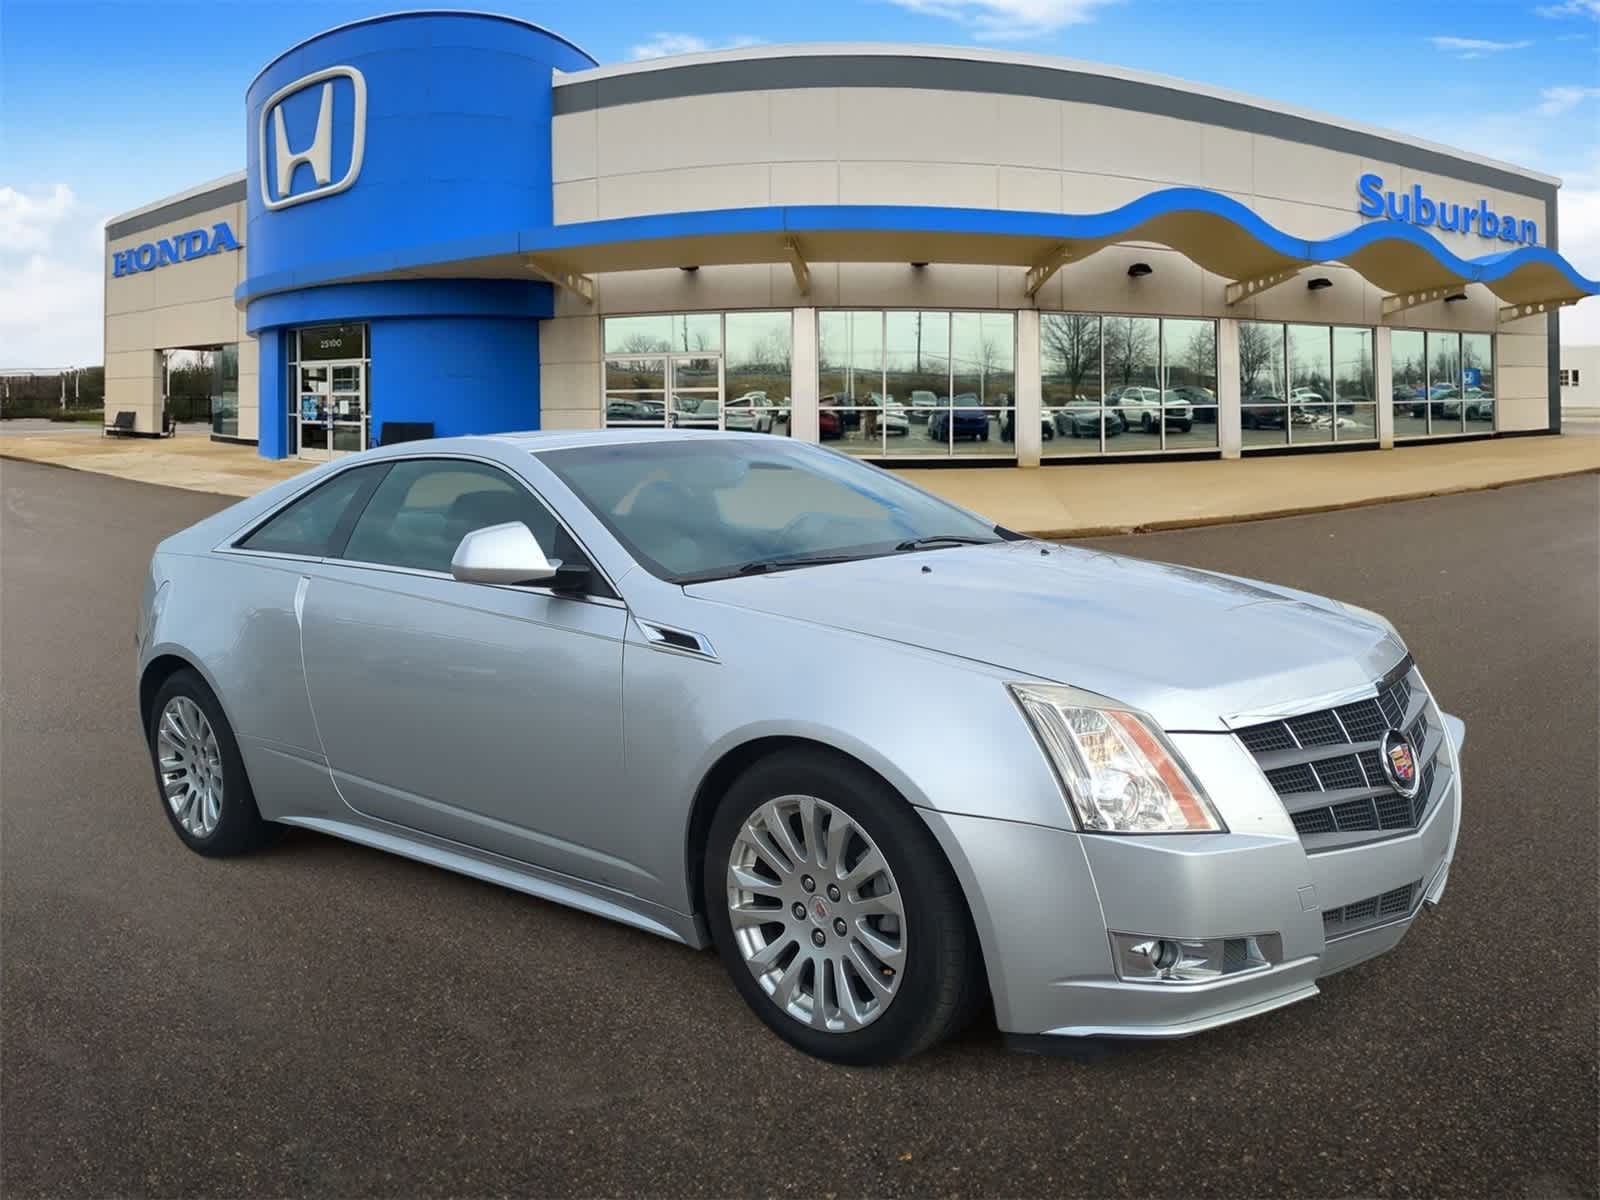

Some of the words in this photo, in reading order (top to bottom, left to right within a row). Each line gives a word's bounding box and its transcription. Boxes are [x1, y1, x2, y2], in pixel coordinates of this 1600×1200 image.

[273, 81, 334, 198] H
[1358, 173, 1538, 246] Suburban
[112, 221, 240, 278] HONDA
